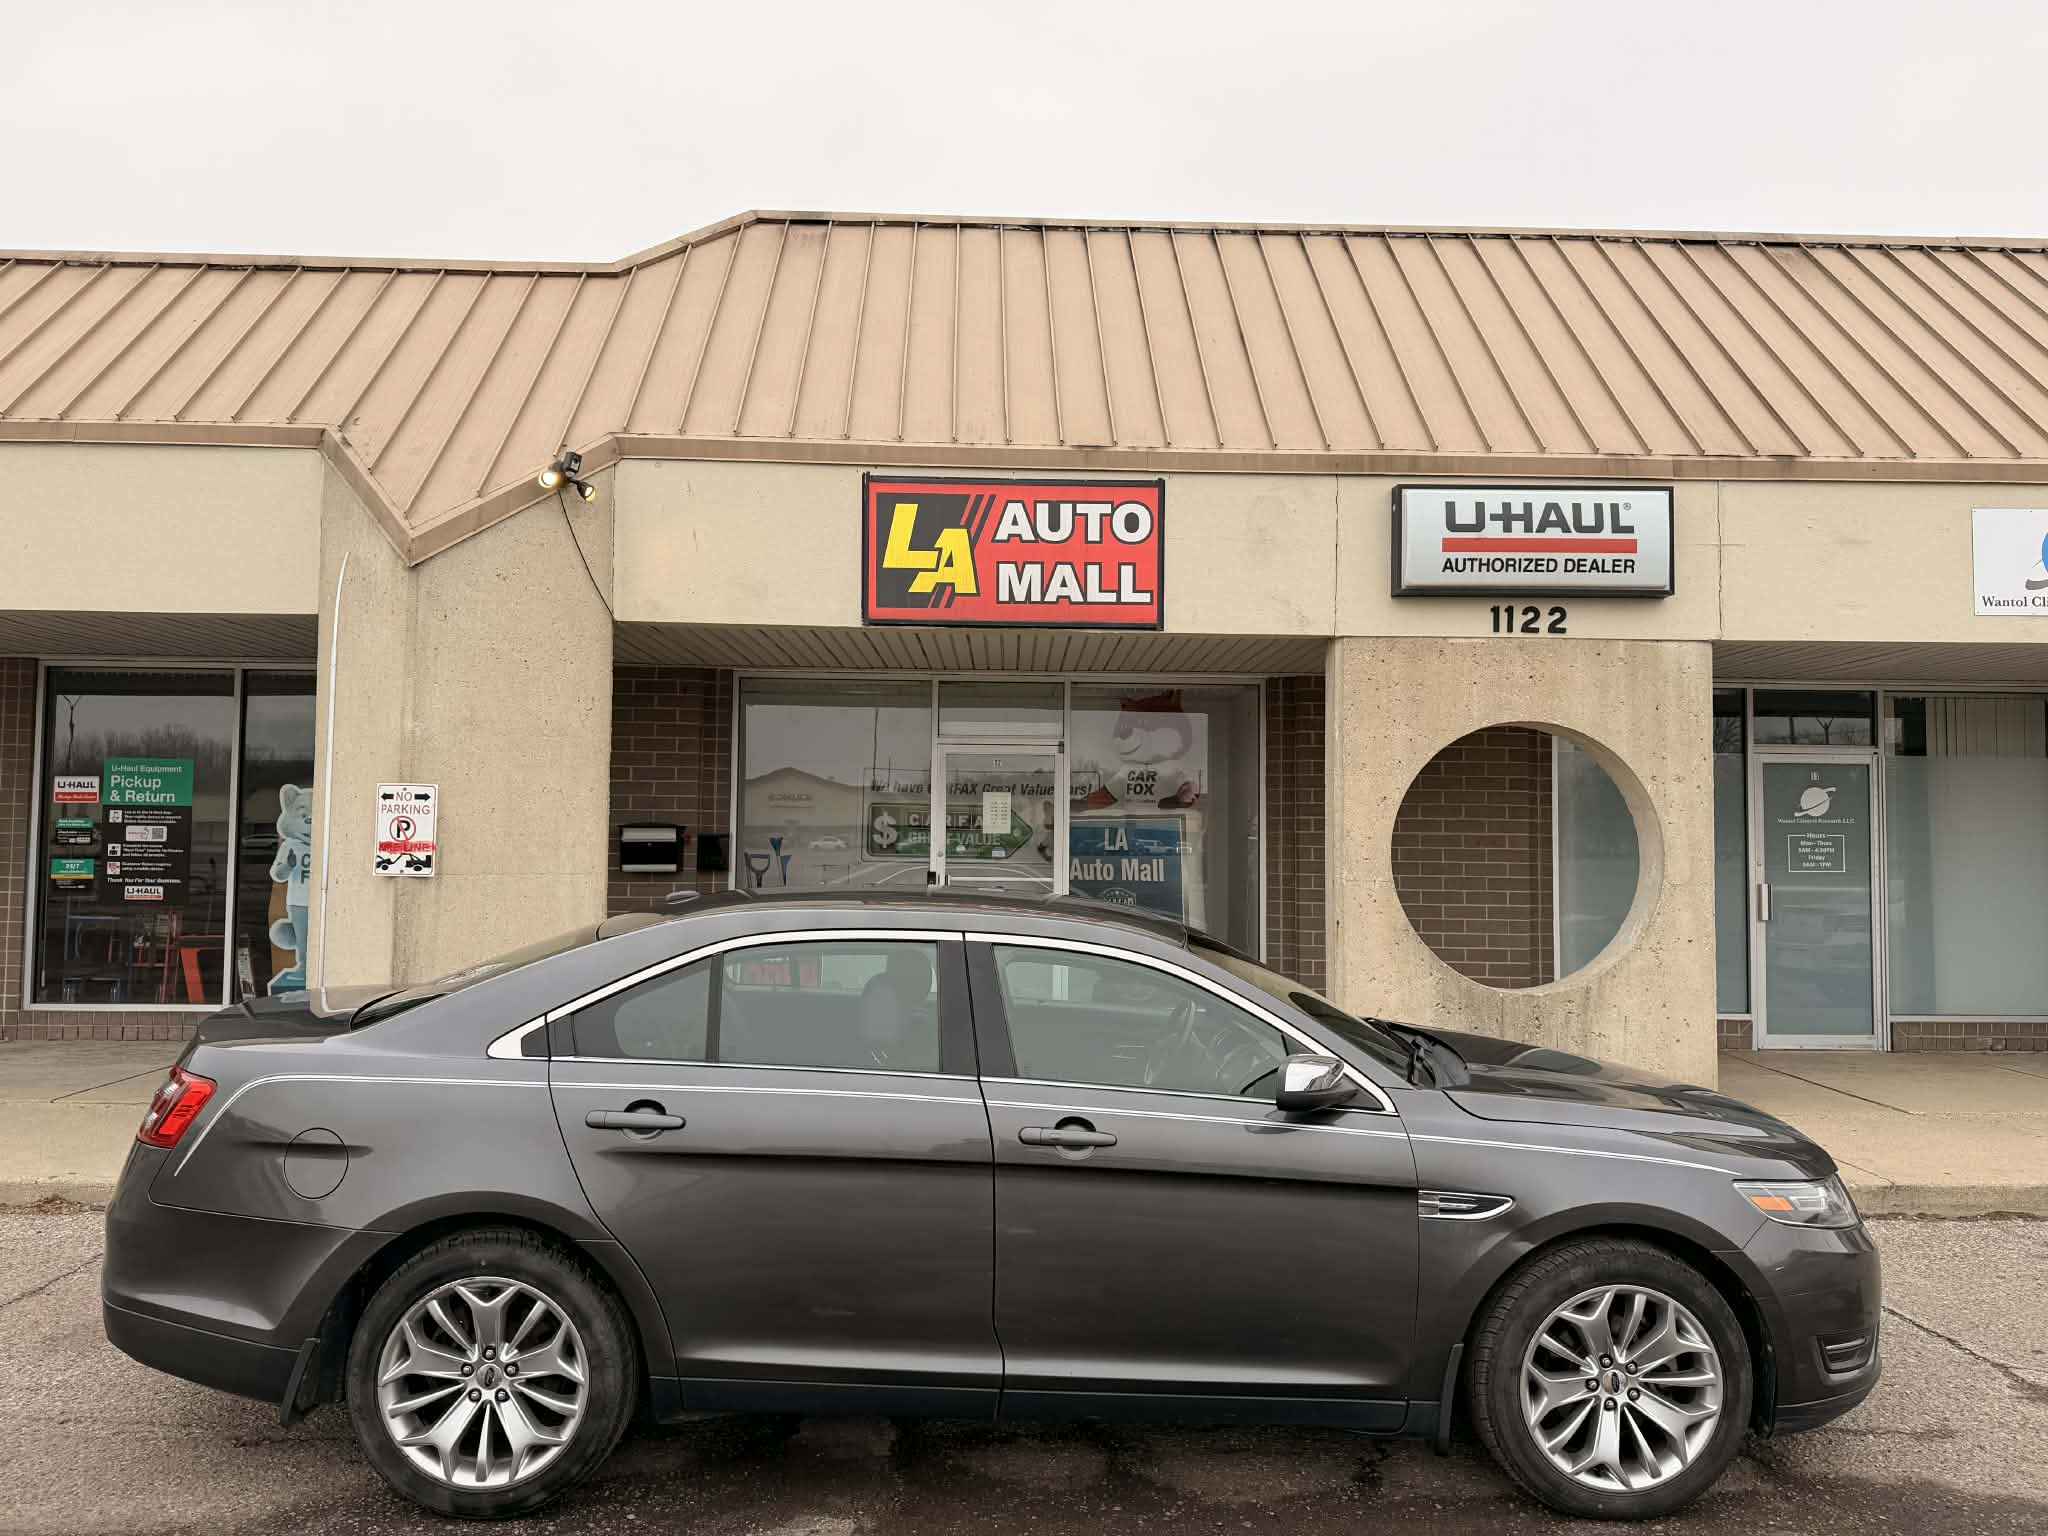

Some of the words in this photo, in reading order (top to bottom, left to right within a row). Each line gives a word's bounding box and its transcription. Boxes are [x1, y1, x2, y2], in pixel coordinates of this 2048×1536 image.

[993, 502, 1152, 543] AUTO
[883, 504, 977, 594] LA
[1442, 557, 1558, 574] AUTHORIZED
[1563, 558, 1636, 574] DEALER
[998, 562, 1152, 603] MALL
[1982, 595, 2028, 608] Wantol
[1490, 605, 1567, 634] 1122
[112, 763, 138, 773] U-Haul
[110, 775, 162, 791] Pickup
[1127, 769, 1158, 783] CAR
[57, 781, 96, 789] U-HAUL
[1126, 783, 1155, 796] FOX
[110, 789, 120, 802] &
[125, 789, 176, 803] Return
[395, 791, 413, 802] NO
[381, 803, 431, 815] PARKING
[1103, 828, 1129, 851] LA
[1070, 858, 1115, 881] Auto
[1121, 858, 1165, 882] Mall
[126, 887, 161, 895] U-HAUL
